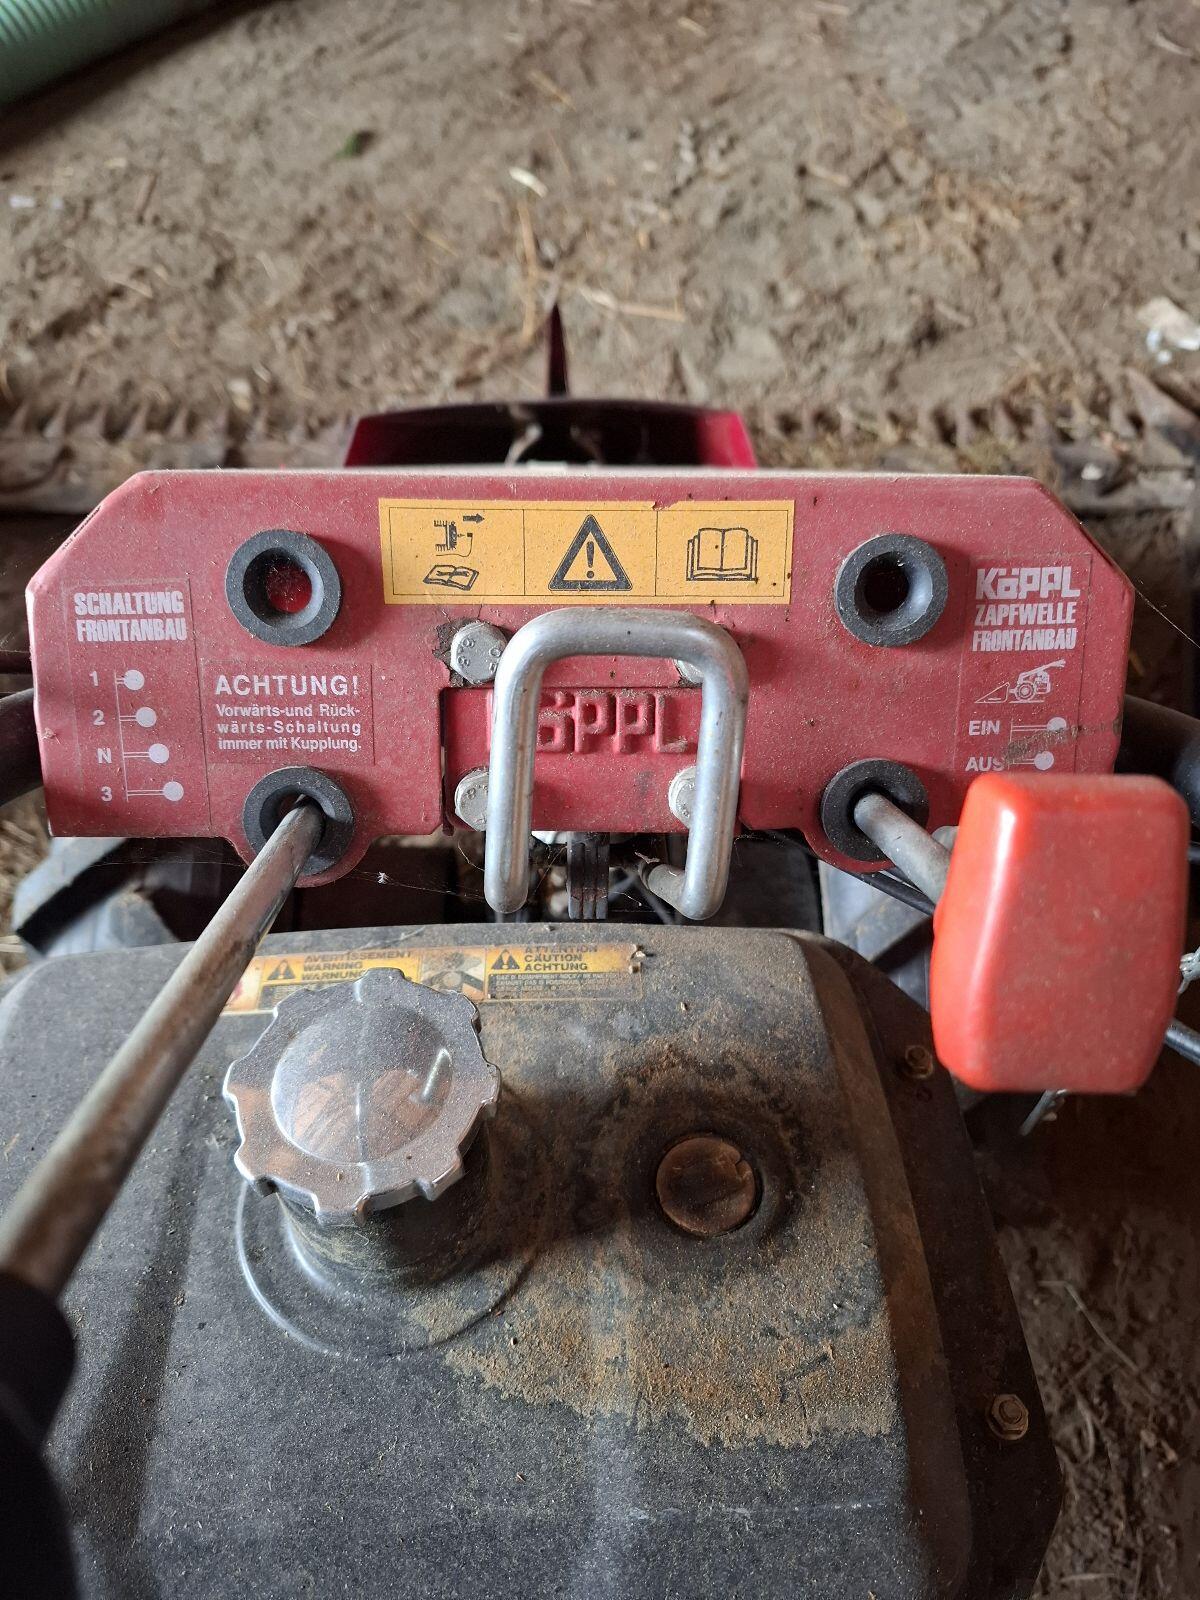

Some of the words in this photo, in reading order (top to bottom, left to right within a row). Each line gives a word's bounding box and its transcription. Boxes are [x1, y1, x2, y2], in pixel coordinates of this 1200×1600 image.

[73, 590, 185, 616] SCHALTUNG
[974, 601, 1077, 626] ZAPFWELLE
[76, 617, 188, 642] FRONTANBAU
[972, 628, 1078, 652] FRONTANBAU
[89, 670, 99, 687] 1
[215, 674, 360, 696] ACHTUNG!
[93, 710, 106, 726] 2
[319, 703, 361, 717] Rück-
[217, 720, 362, 735] wärts-Schaltung
[968, 720, 1001, 737] EIN
[218, 737, 263, 751] immer
[266, 736, 288, 750] mit
[290, 736, 362, 753] Kupplung.
[97, 748, 112, 764] N
[965, 756, 1006, 773] AUS
[101, 786, 113, 802] 3
[524, 953, 583, 962] CAUTION
[303, 962, 363, 972] WARNING
[524, 962, 588, 972] ACHTUNG
